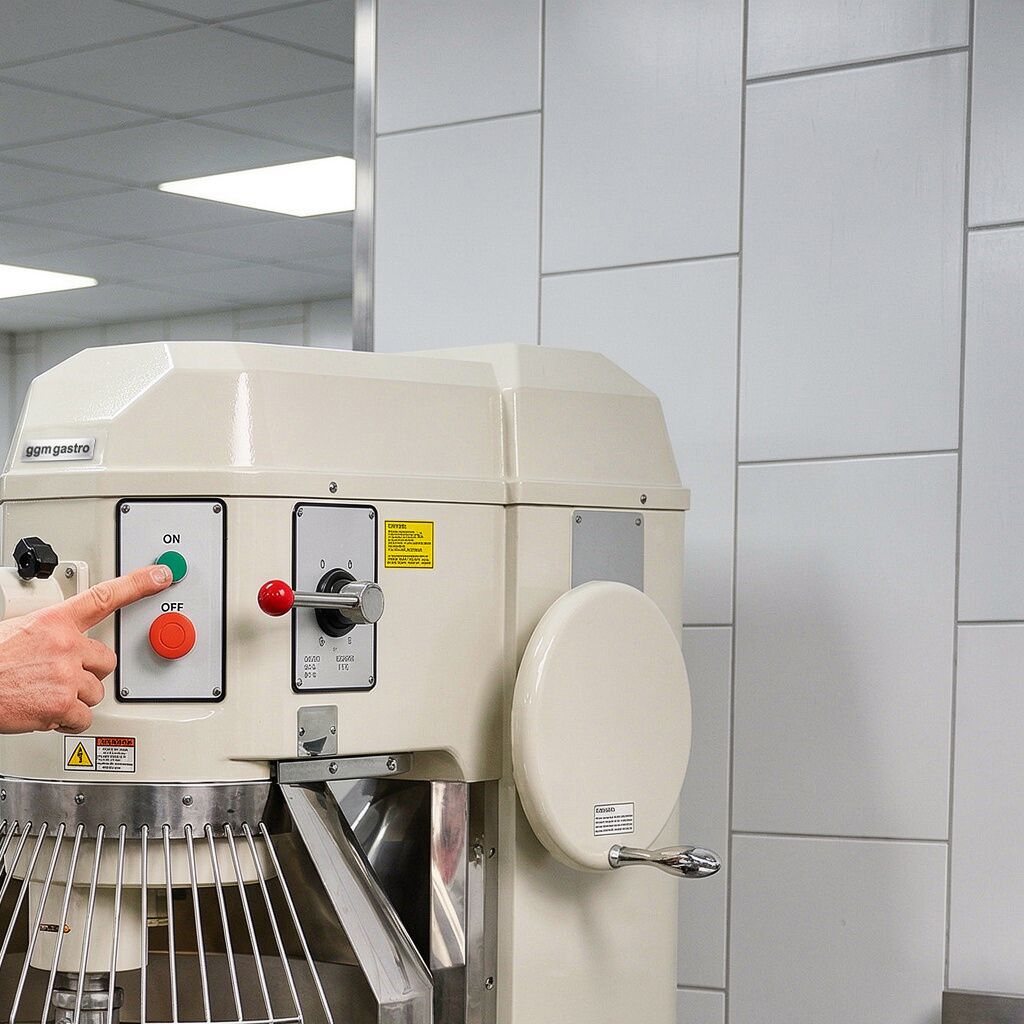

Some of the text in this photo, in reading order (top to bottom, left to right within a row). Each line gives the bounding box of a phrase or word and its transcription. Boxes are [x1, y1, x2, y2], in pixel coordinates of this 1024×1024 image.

[26, 443, 90, 457] ggm gastro
[163, 534, 181, 544] ON
[161, 602, 184, 612] OFF
